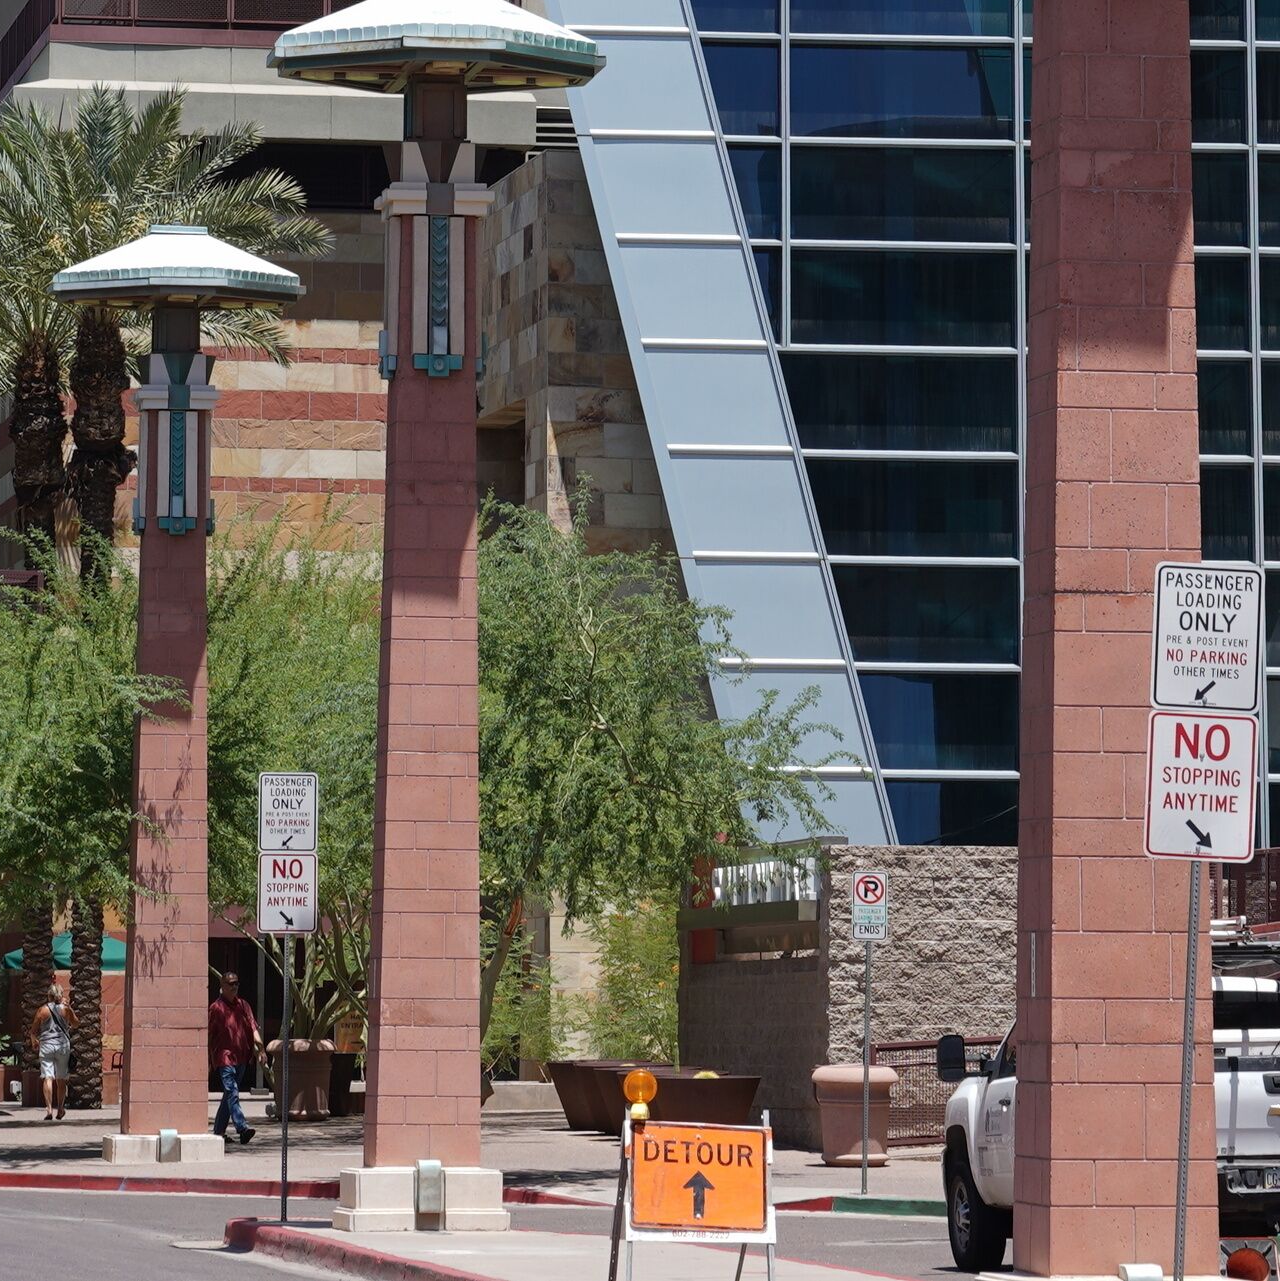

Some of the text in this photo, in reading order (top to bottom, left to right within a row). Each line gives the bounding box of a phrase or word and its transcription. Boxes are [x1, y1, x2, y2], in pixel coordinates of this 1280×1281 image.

[1165, 572, 1254, 592] PASSENGER
[1176, 591, 1242, 610] LOADING
[1179, 610, 1237, 633] ONLY
[1166, 634, 1249, 648] PRE & POST EVENT
[1166, 648, 1248, 666] NO PARKING
[1173, 666, 1240, 680] OTHER TIMES
[1174, 722, 1231, 762] NO
[264, 777, 313, 787] PASSENGER
[1162, 766, 1241, 788] STOPPING
[270, 788, 307, 797] LOADING
[272, 798, 304, 810] ONLY
[1162, 791, 1239, 813] ANYTIME
[265, 819, 310, 827] NO PARKING
[272, 858, 303, 879] NO
[266, 882, 309, 893] STOPPING
[267, 896, 308, 907] ANYTIME
[859, 924, 880, 935] ENDS
[643, 1139, 753, 1168] DETOUR
